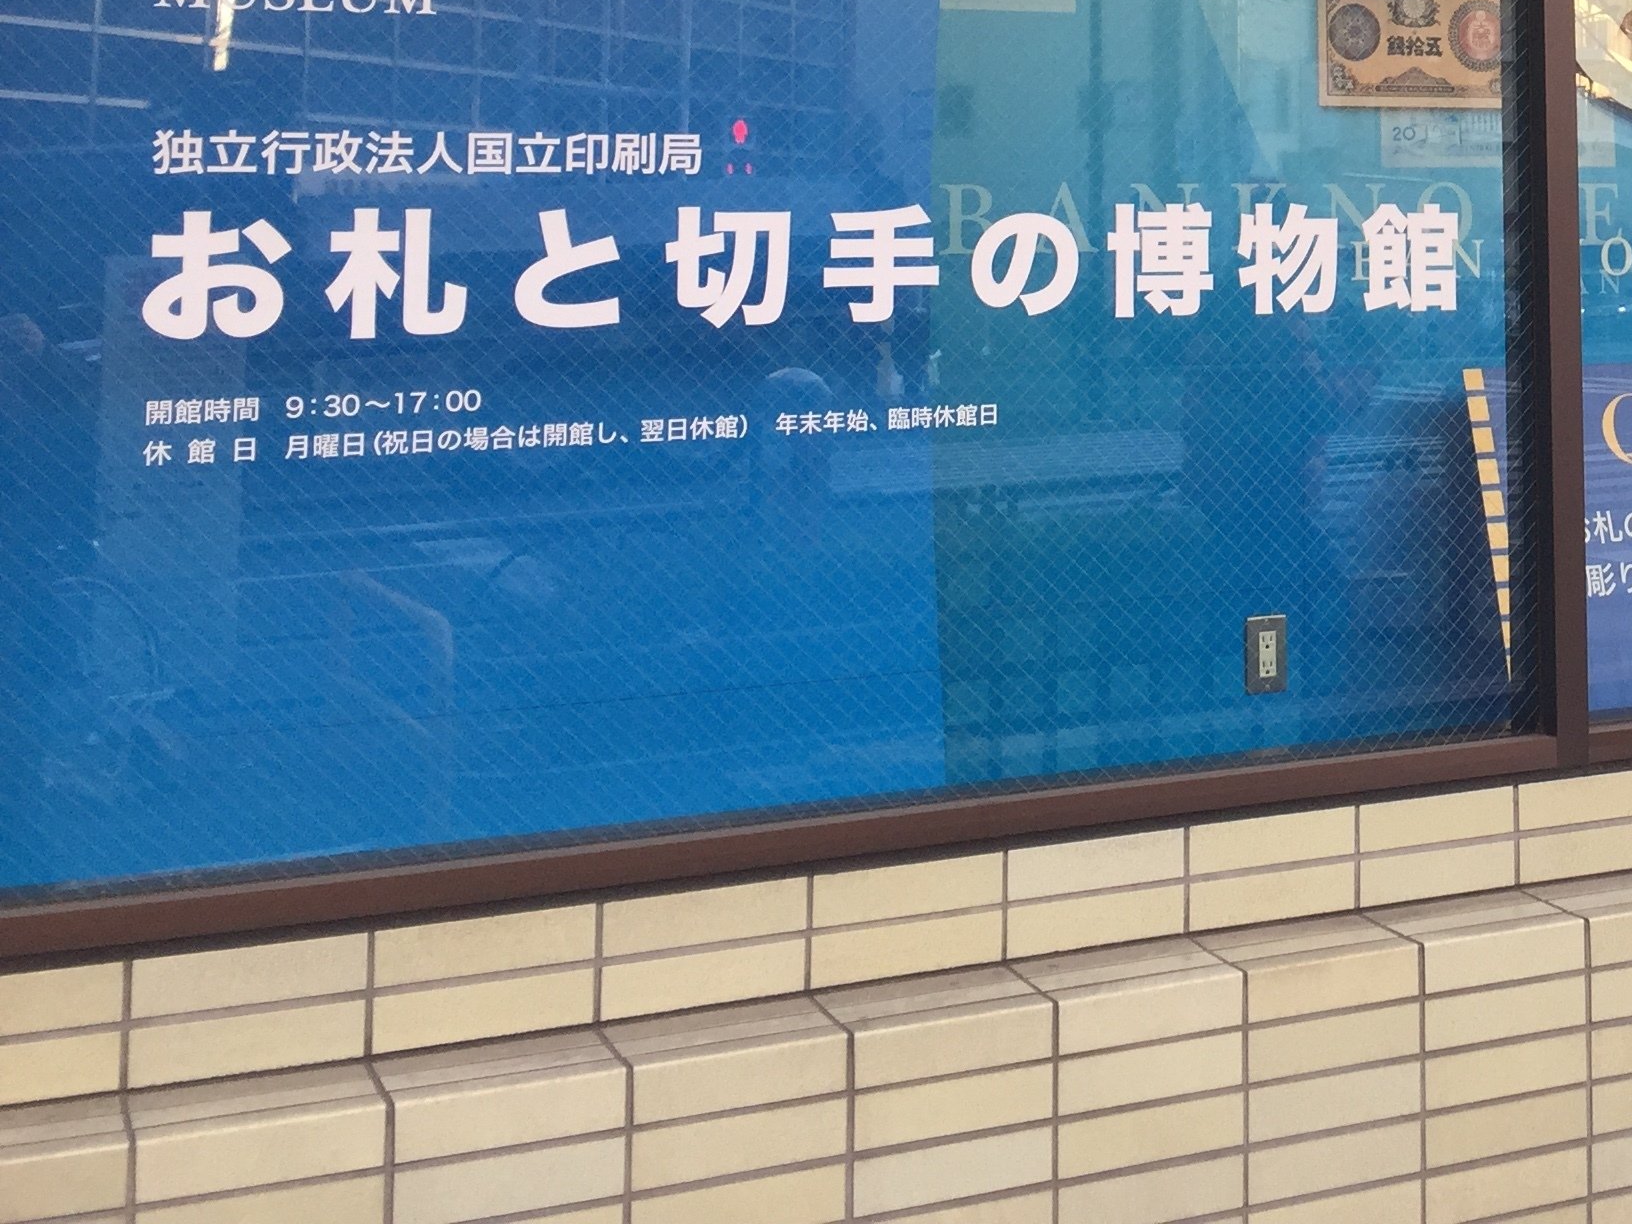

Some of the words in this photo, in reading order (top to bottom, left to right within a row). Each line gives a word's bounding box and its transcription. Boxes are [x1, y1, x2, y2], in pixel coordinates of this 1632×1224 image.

[152, 127, 704, 178] 独立行政法人国立印刷局
[142, 204, 1460, 340] お札と切手の博物館
[144, 394, 261, 425] 開館時間
[775, 403, 1000, 438] 年末年始、臨時休館日
